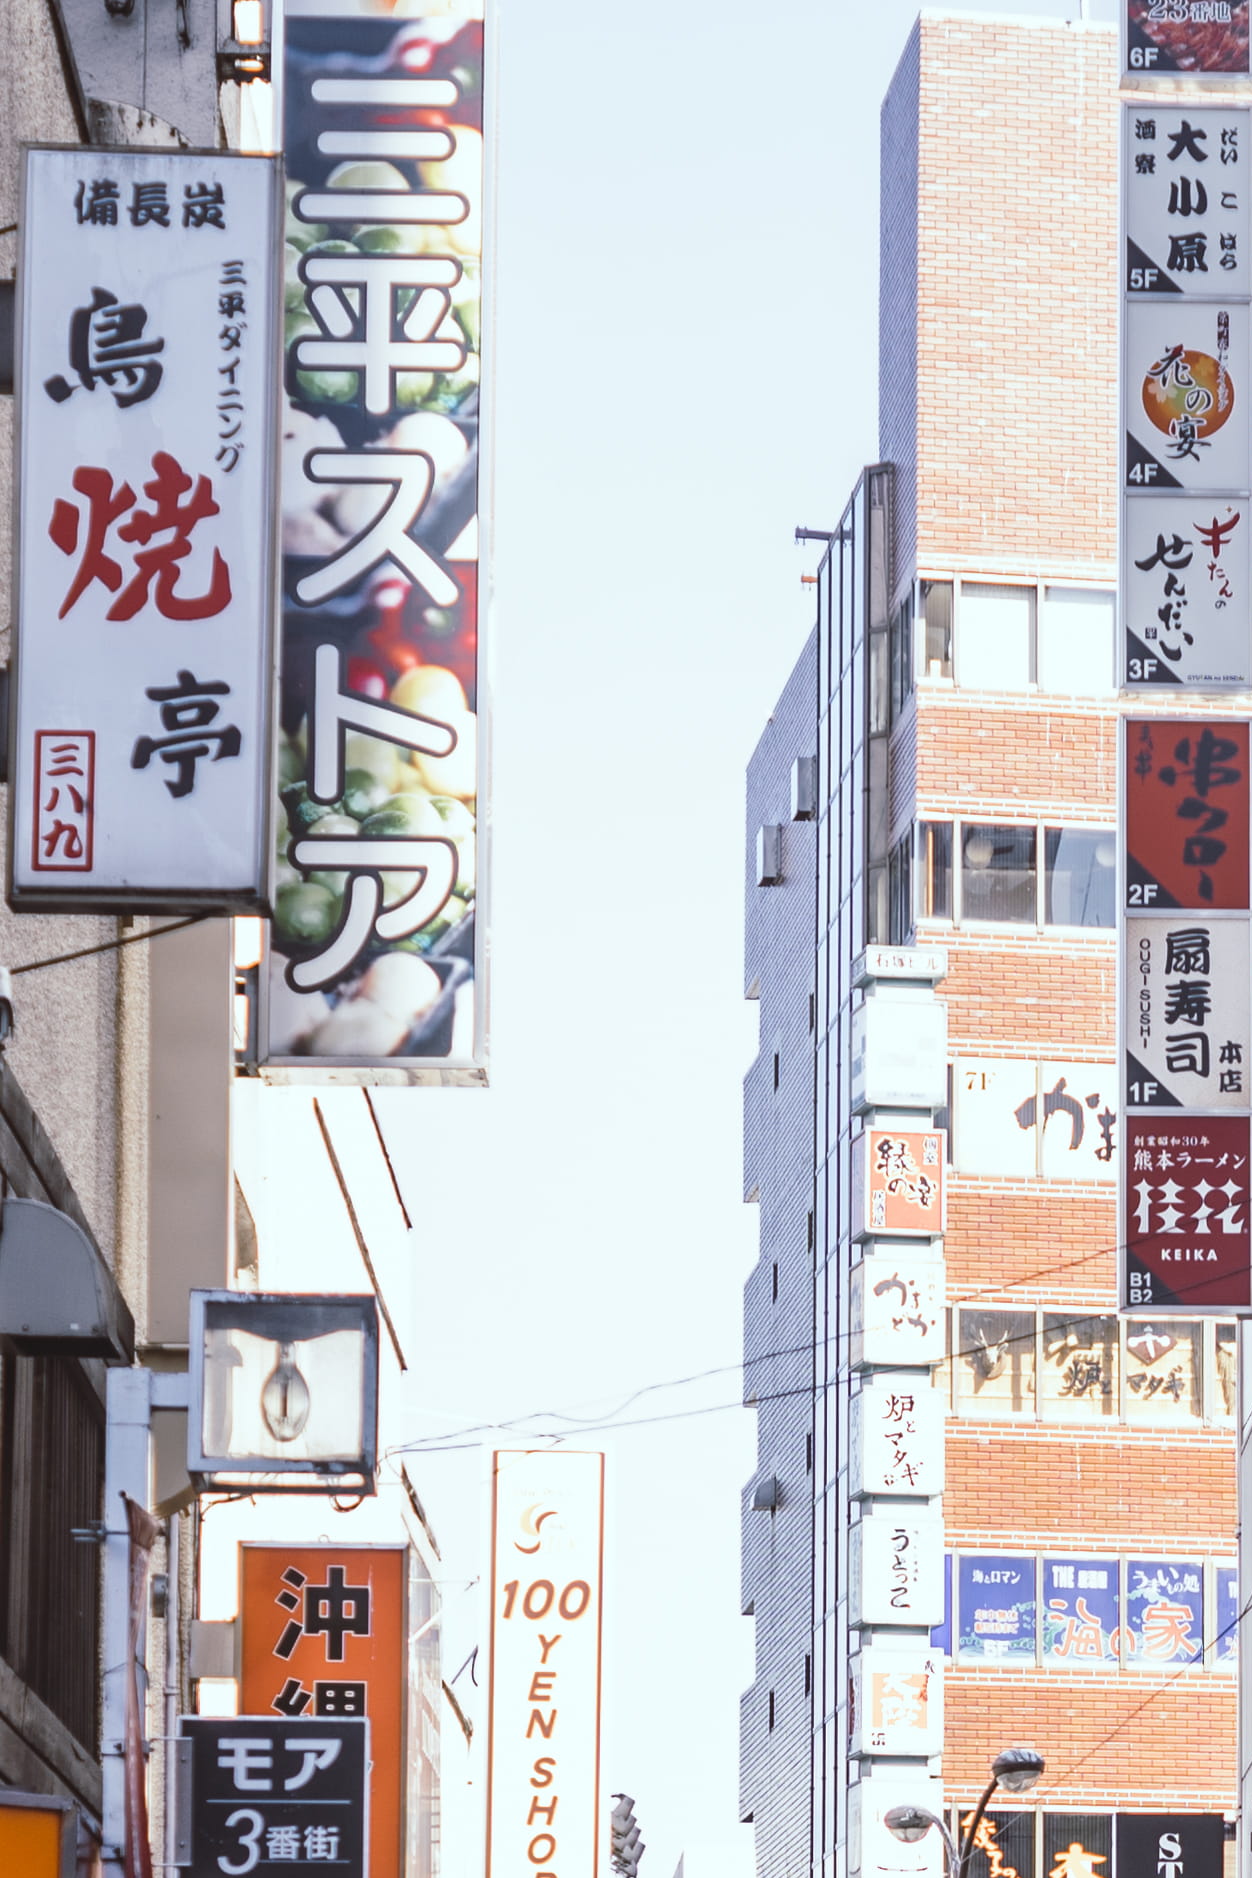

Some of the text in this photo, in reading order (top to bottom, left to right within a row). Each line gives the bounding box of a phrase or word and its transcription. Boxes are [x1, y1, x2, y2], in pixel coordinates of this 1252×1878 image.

[1130, 47, 1158, 68] 6F
[73, 180, 226, 230] 備長炭
[1167, 120, 1208, 273] 大小原
[1130, 269, 1158, 289] 5F
[215, 260, 249, 474] 三平ダイニング
[1129, 463, 1158, 484] 4F
[287, 77, 471, 990] 三平ストア
[1129, 659, 1158, 679] 3F
[42, 744, 84, 858] 三八九
[1129, 885, 1157, 904] 2F
[1139, 939, 1151, 1048] OUGI SUSHI
[1164, 927, 1211, 1078] 扇寿司
[1219, 1041, 1243, 1093] 本店
[1129, 1082, 1158, 1103] 1F
[1133, 1150, 1246, 1171] 熊本ラーメン
[1130, 1272, 1151, 1287] B1
[1161, 1249, 1217, 1261] KEIKA
[1130, 1289, 1152, 1303] B2
[503, 1579, 591, 1621] 100
[1048, 1597, 1197, 1661] 海の家
[525, 1634, 562, 1739] YEN
[217, 1737, 343, 1791] モア
[217, 1810, 342, 1876] 3番街
